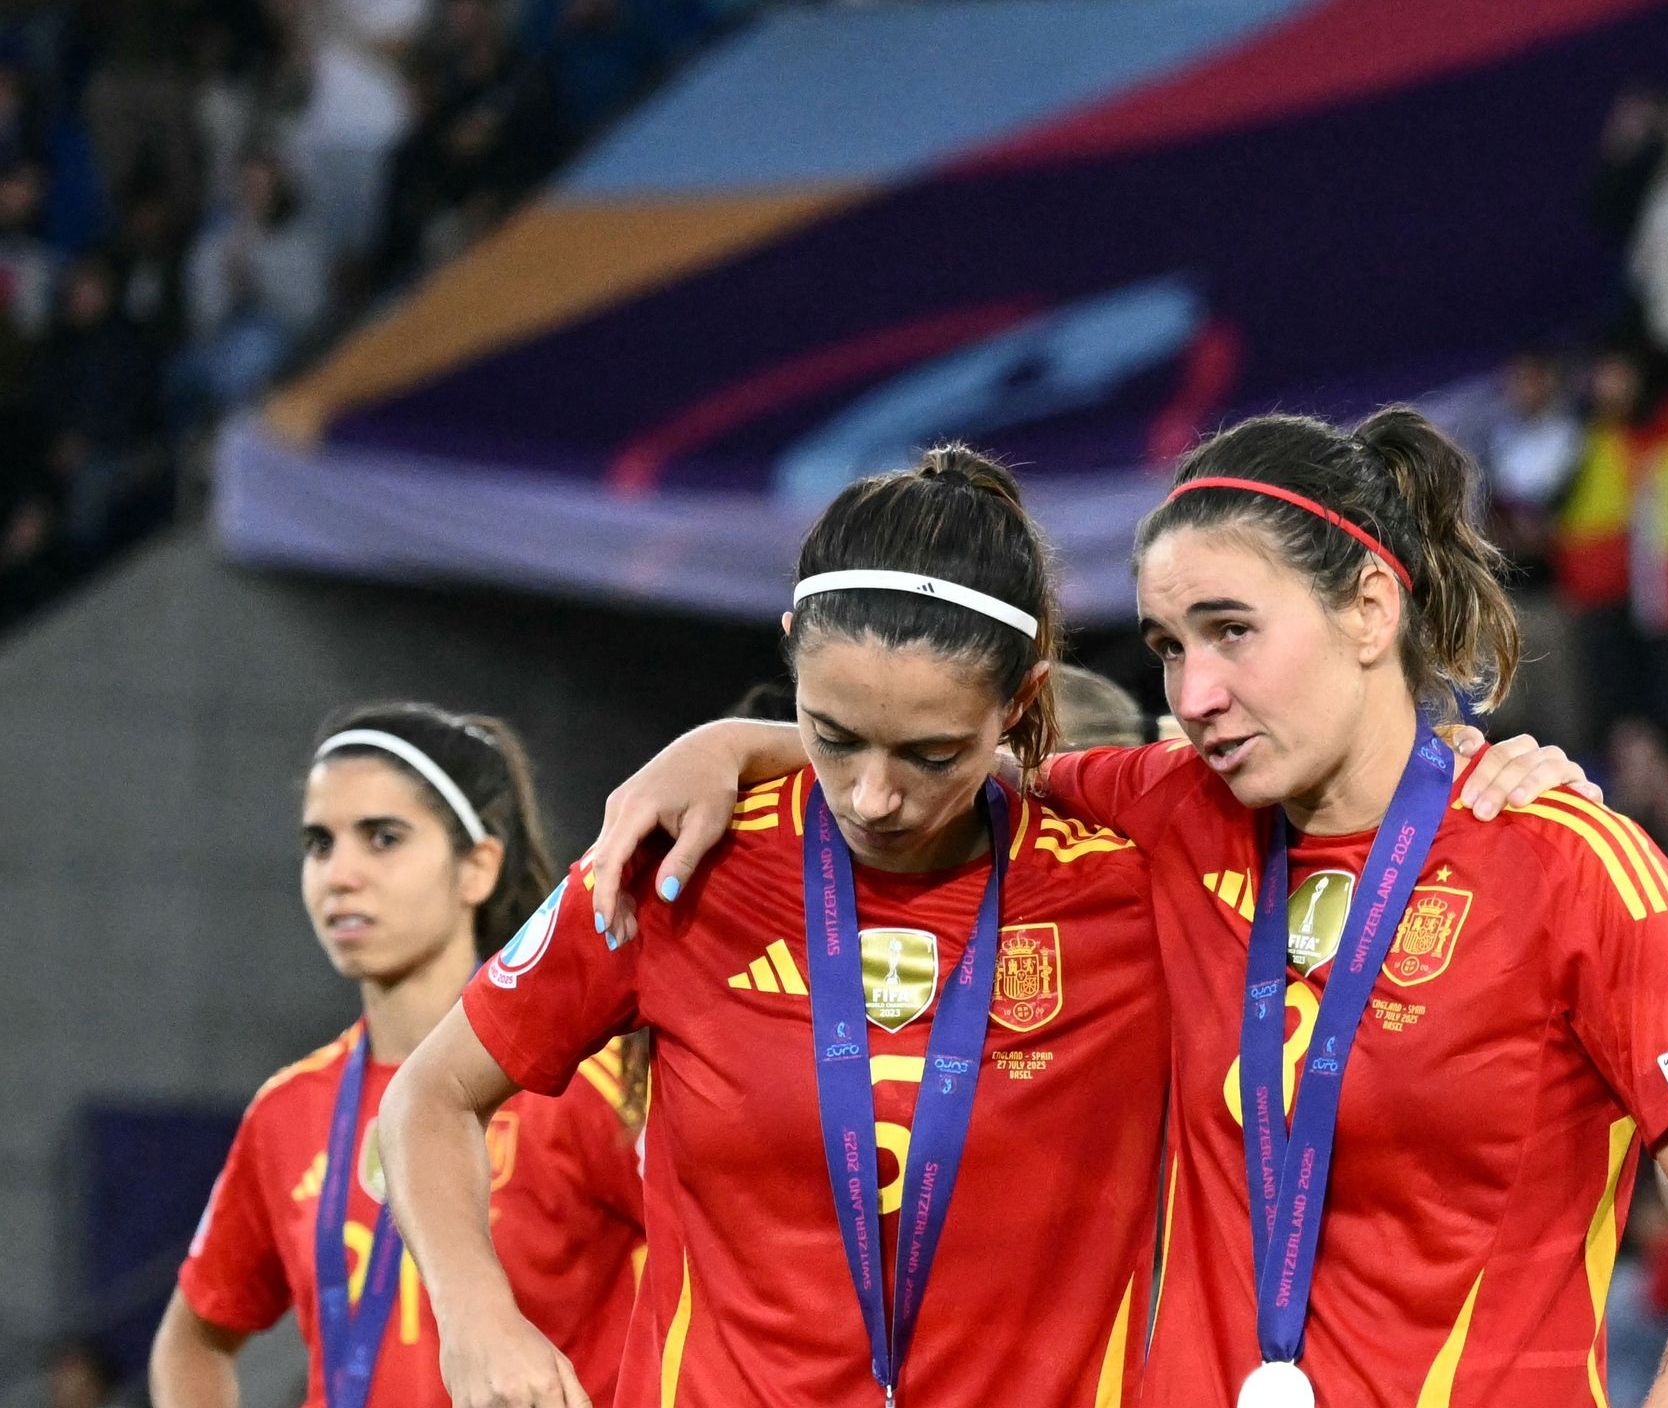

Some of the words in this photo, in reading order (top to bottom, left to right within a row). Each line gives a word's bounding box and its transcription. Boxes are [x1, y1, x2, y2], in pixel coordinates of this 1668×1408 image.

[820, 847, 841, 957] SWITZERLAND
[1350, 867, 1398, 974] SWITZERLAND
[1391, 825, 1416, 865] 2025
[1289, 935, 1316, 951] FIFA
[992, 1051, 1023, 1060] ENGLAND
[1031, 1051, 1053, 1060] SPAIN
[997, 1061, 1006, 1069] 27
[1008, 1061, 1025, 1069] JULY
[1027, 1061, 1046, 1069] 2025
[1009, 1070, 1032, 1079] BASEL
[844, 1131, 859, 1173] 2025
[850, 1177, 872, 1290] SWITZERLAND
[1275, 1195, 1307, 1308] SWITZERLAND
